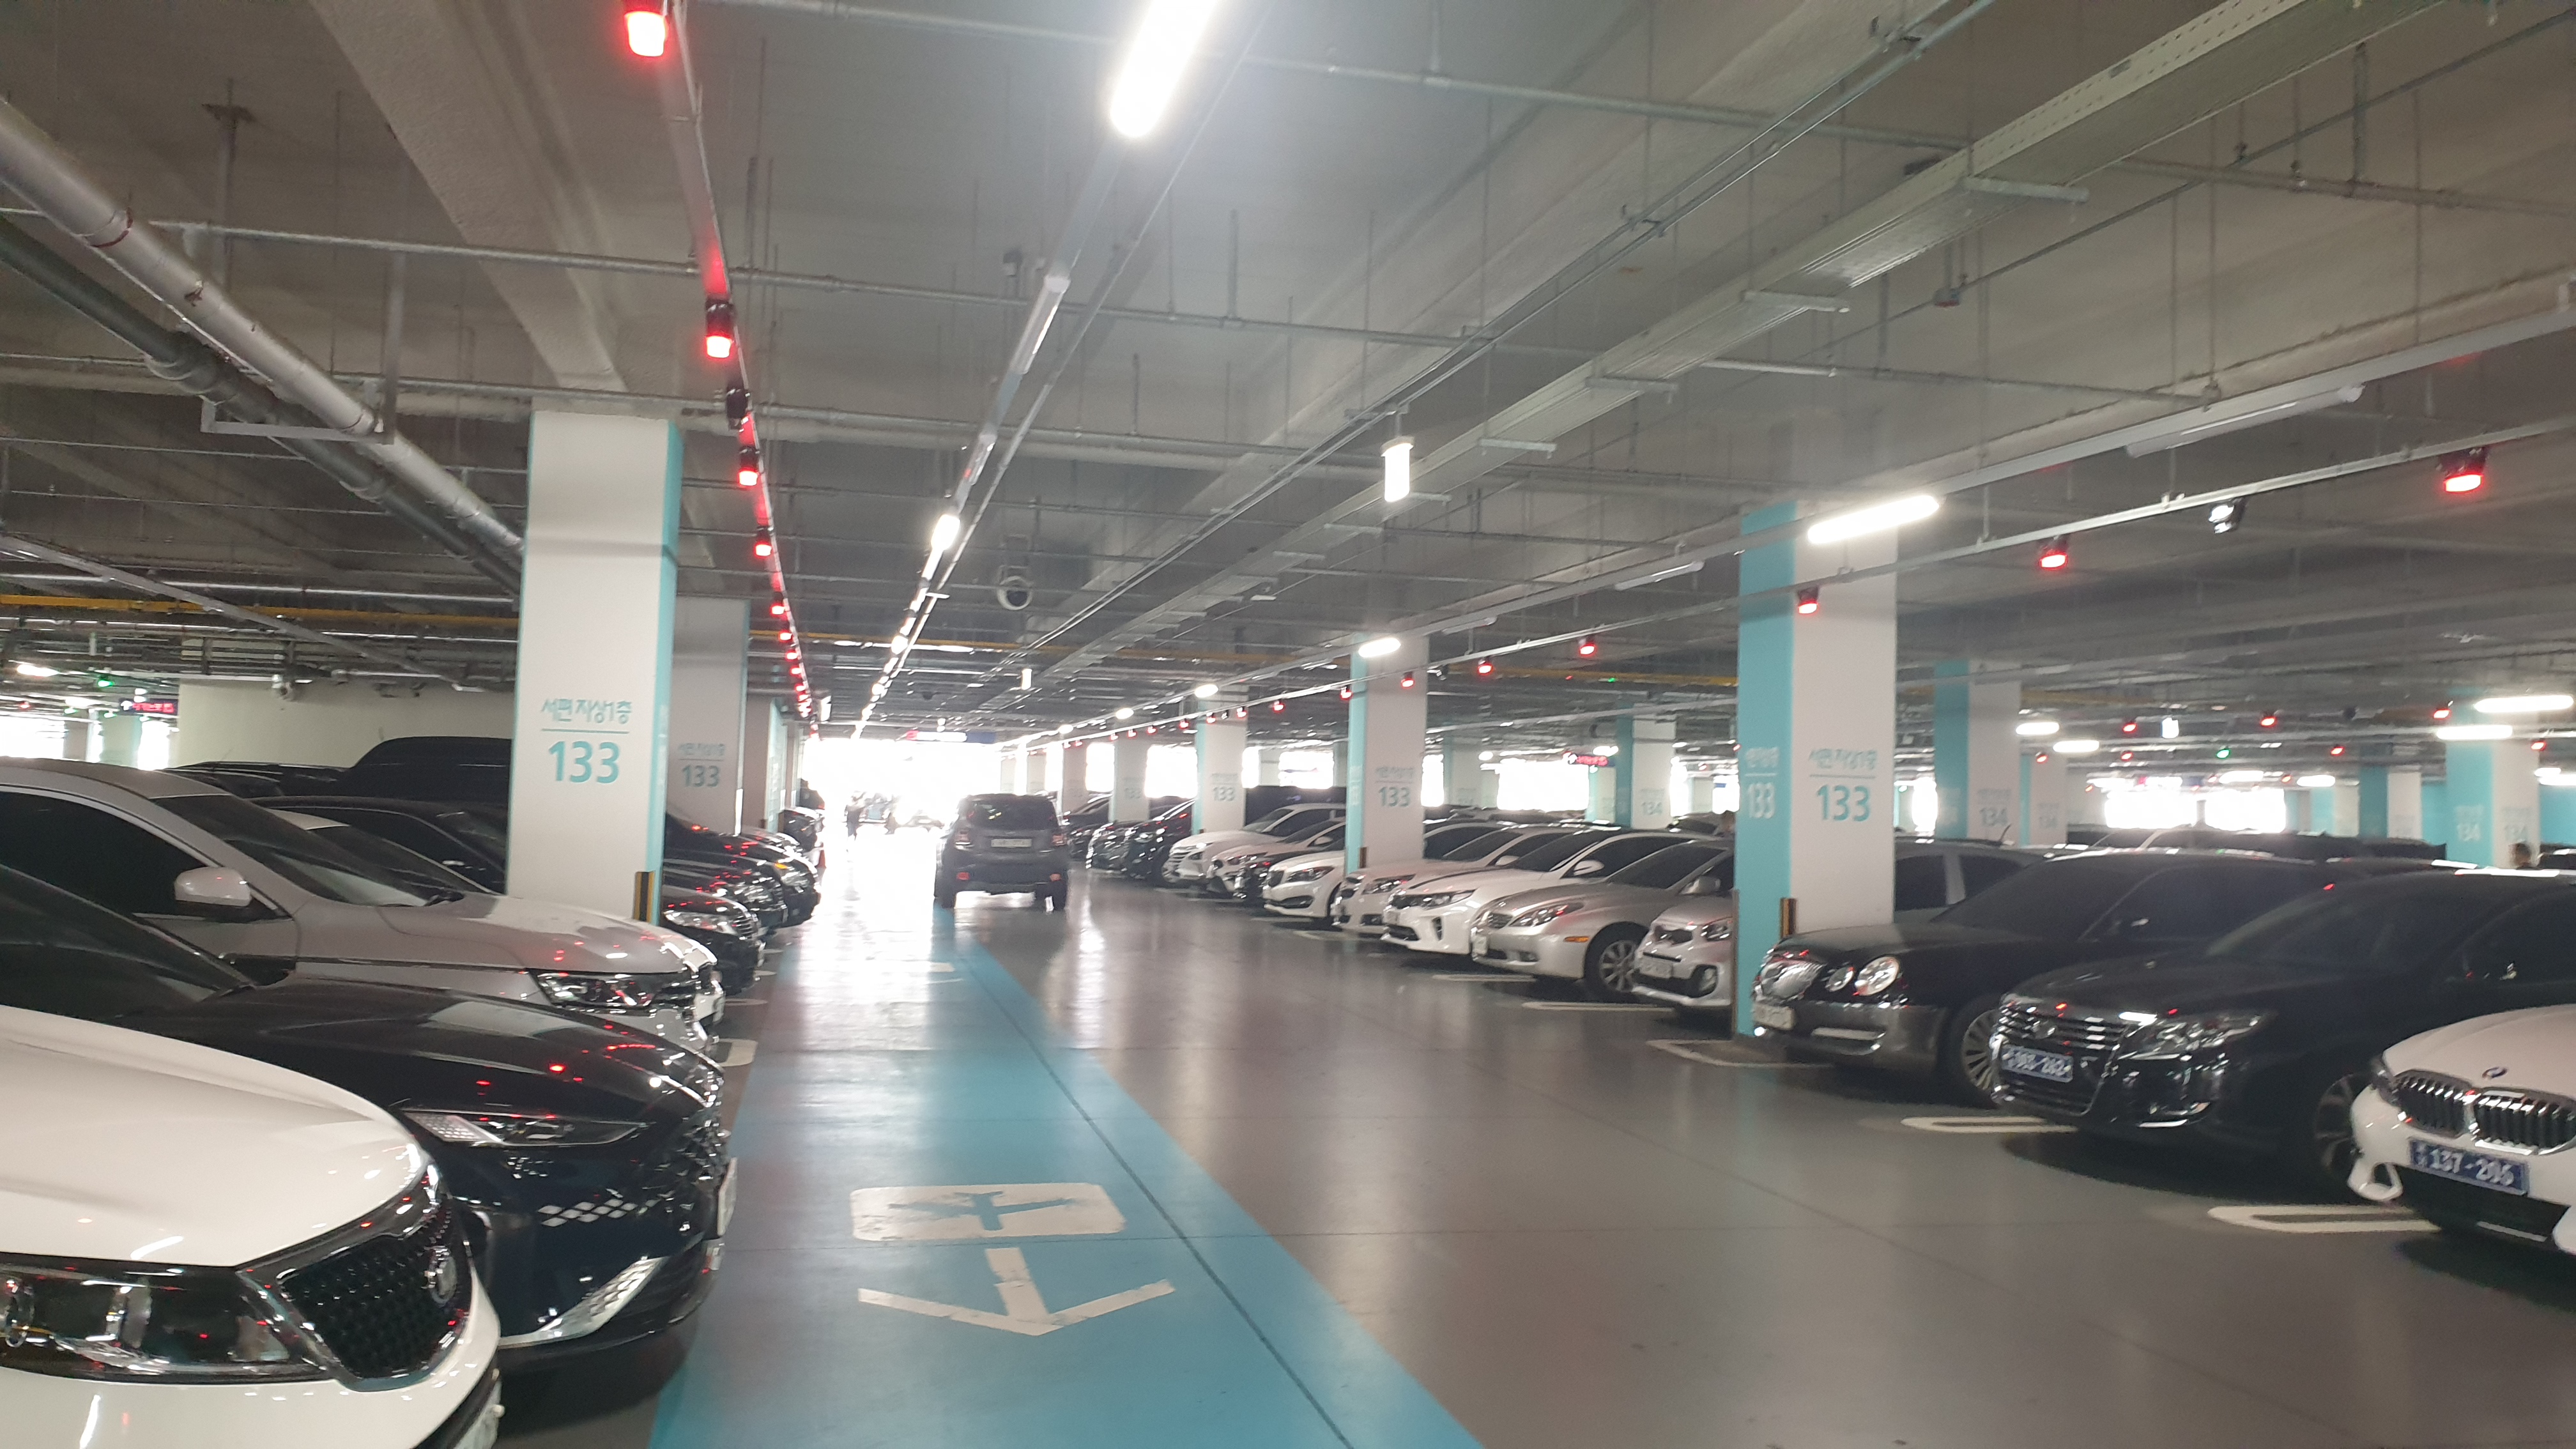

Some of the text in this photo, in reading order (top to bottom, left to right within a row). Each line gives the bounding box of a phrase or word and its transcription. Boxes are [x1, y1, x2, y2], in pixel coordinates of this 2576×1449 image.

[548, 740, 620, 784] 133
[681, 765, 720, 787] 133
[1213, 786, 1236, 802] 133
[1379, 786, 1411, 807] 133
[1747, 782, 1776, 819] 133
[1816, 784, 1871, 822] 133
